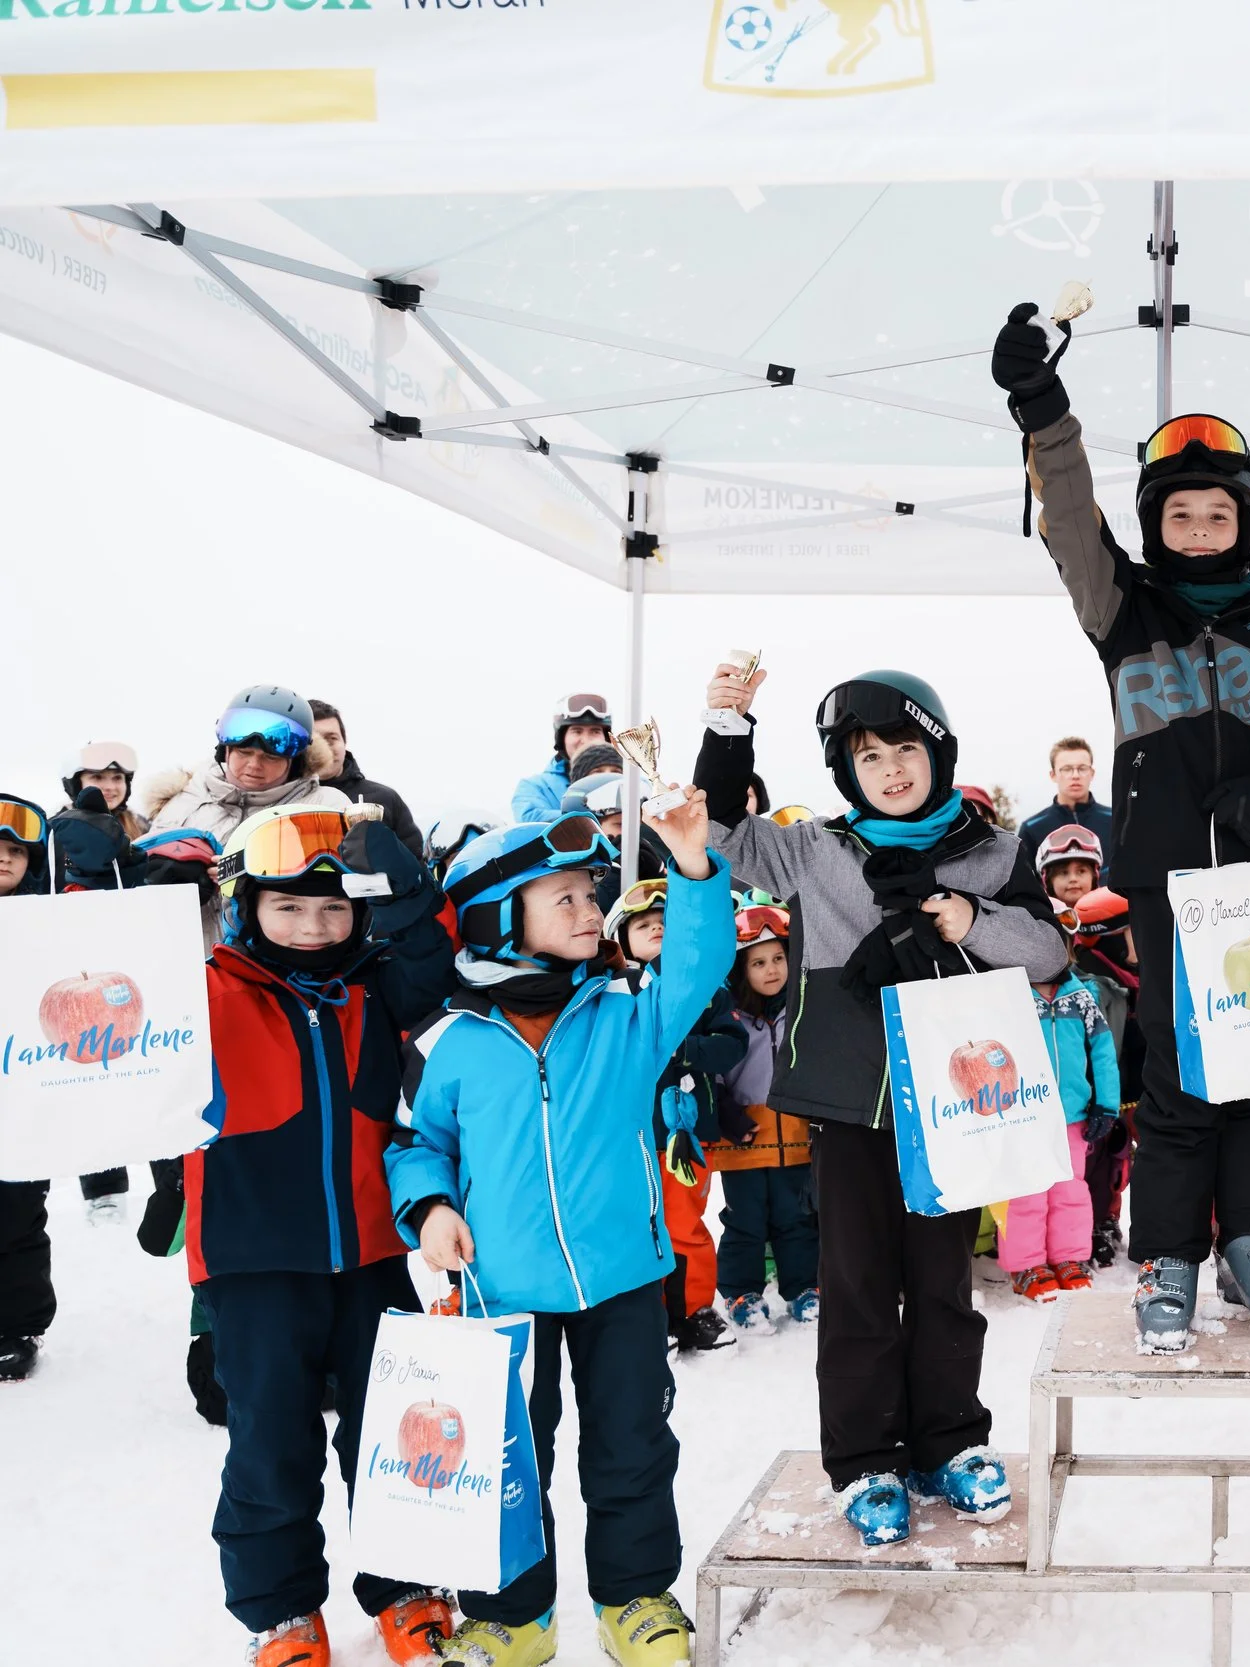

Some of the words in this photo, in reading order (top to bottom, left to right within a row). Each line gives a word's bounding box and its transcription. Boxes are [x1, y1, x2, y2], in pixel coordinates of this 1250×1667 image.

[918, 712, 946, 741] BLIZ
[1211, 898, 1250, 926] Marcel
[1207, 988, 1214, 1021] I
[1216, 990, 1246, 1012] am
[0, 1034, 14, 1075] I
[18, 1041, 69, 1065] am
[76, 1019, 195, 1071] Marlene
[41, 1075, 94, 1087] DAUGHTER
[99, 1073, 112, 1081] OF
[115, 1070, 133, 1078] THE
[136, 1067, 161, 1076] ALPS
[931, 1095, 939, 1129] I
[942, 1099, 974, 1121] am
[977, 1076, 1051, 1120] Marlene
[962, 1125, 996, 1137] DAUGHTER
[1022, 1115, 1037, 1124] ALPS
[368, 1442, 381, 1479] I
[379, 1457, 410, 1477] am
[415, 1453, 492, 1498] Marlene
[387, 1493, 422, 1506] DAUGHTER
